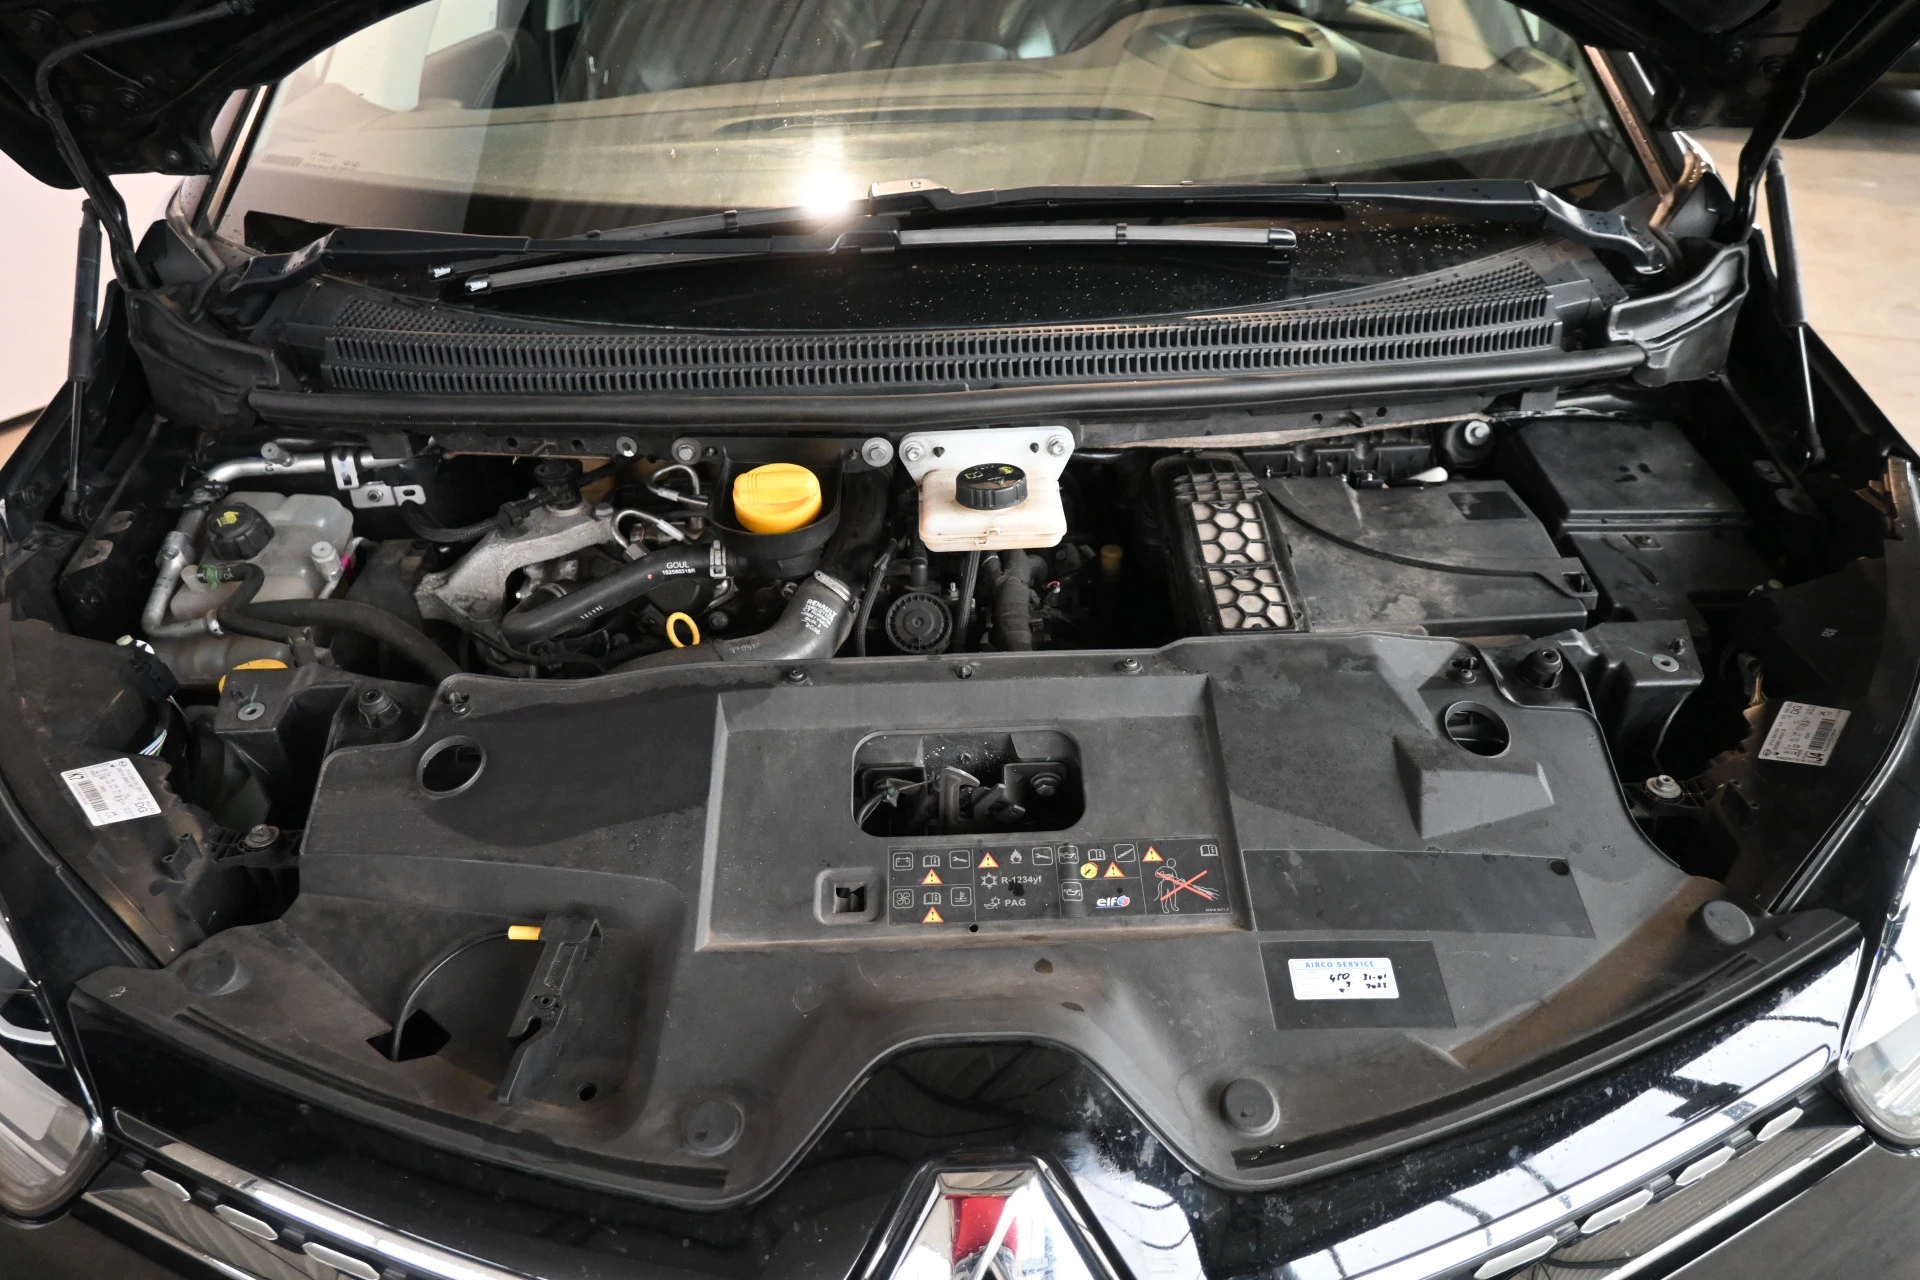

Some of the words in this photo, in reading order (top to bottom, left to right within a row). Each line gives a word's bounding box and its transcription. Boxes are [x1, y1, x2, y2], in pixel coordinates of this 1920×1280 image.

[666, 561, 690, 569] GOUL
[806, 598, 838, 617] RENAULT
[1001, 875, 1042, 885] R-1234yf
[1005, 898, 1027, 907] PAG
[1096, 896, 1118, 907] elf
[1337, 960, 1375, 968] SERVICE
